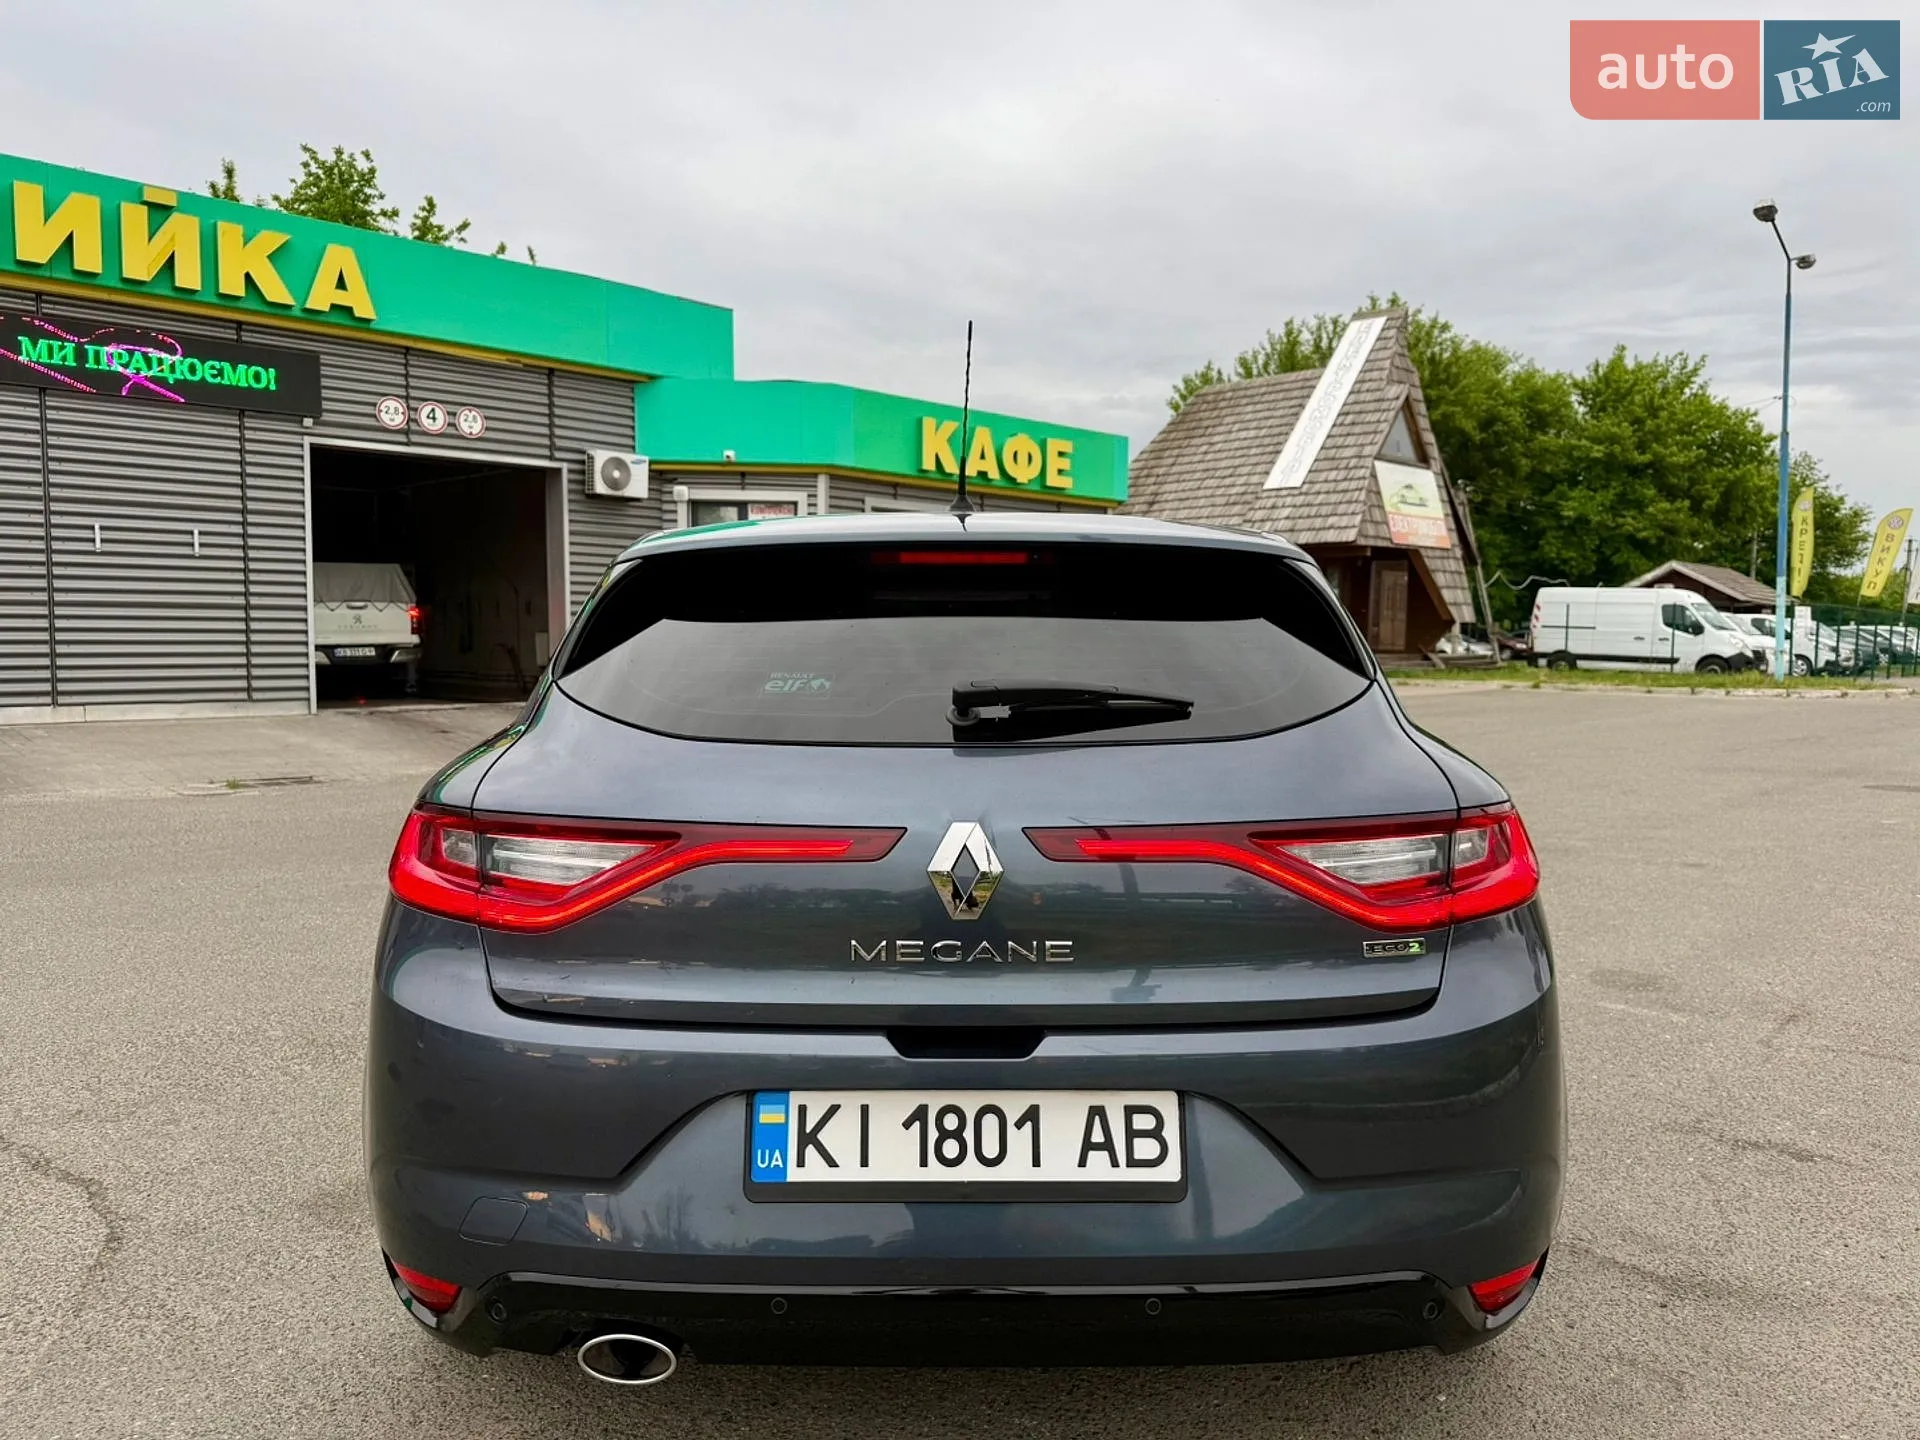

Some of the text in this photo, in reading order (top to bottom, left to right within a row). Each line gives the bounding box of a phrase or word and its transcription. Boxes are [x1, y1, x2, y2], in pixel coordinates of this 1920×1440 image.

[13, 180, 377, 321] ИЙКА
[18, 336, 277, 391] МИ ПРАЦЮЄМО!
[426, 407, 437, 423] 4
[922, 416, 1073, 489] КАФЕ
[1866, 532, 1895, 591] ВИКУП
[764, 679, 809, 692] elf
[850, 939, 1075, 963] MEGANE
[756, 1148, 784, 1168] UA
[795, 1103, 1169, 1168] KI 1801 AB
